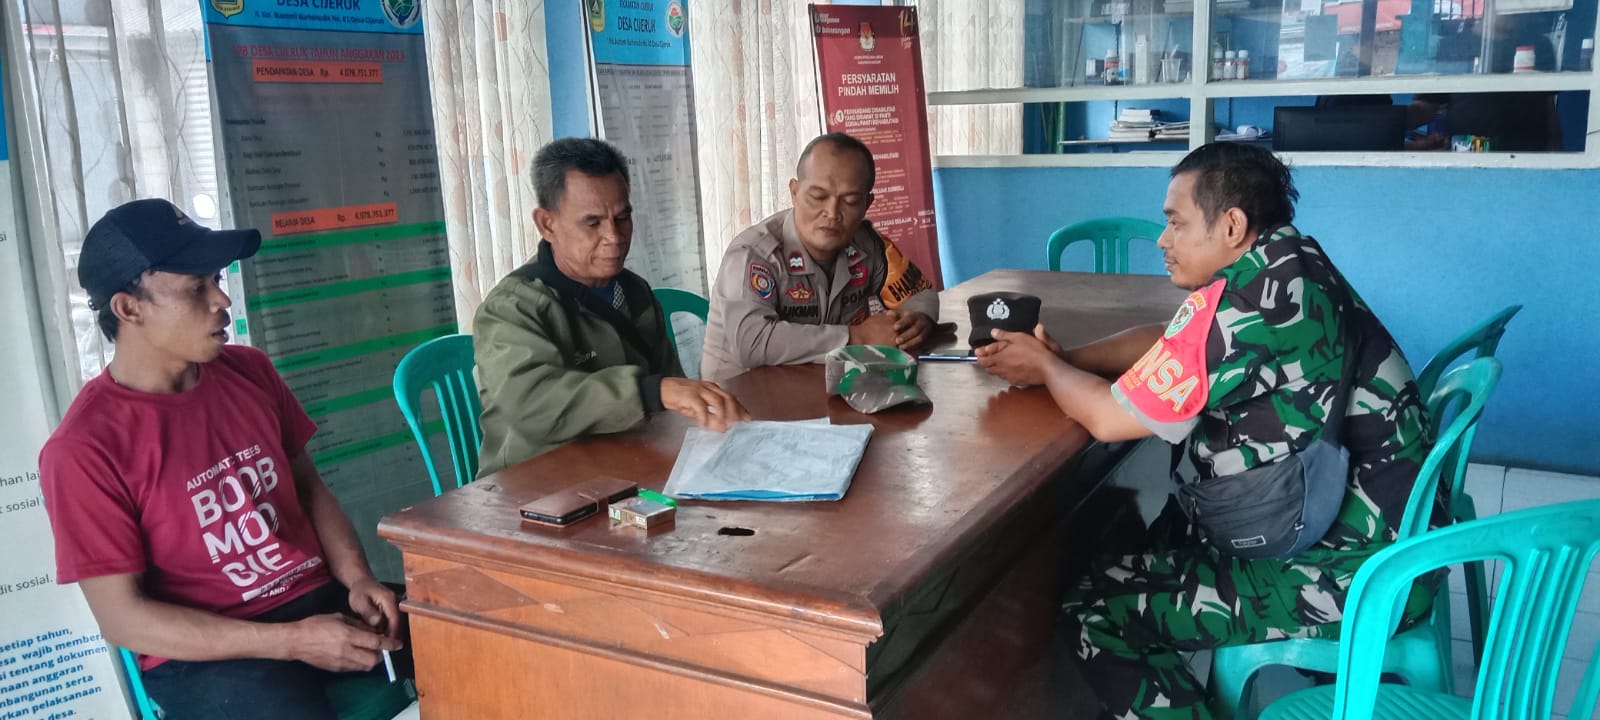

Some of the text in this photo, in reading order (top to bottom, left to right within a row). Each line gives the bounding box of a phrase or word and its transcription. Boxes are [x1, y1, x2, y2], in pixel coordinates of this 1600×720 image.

[618, 16, 632, 31] DESA
[842, 72, 896, 85] PERSYARATAN
[838, 84, 900, 97] PINDAH MEMILIH
[236, 444, 262, 463] TEES
[191, 457, 279, 529] BOOB
[6, 496, 40, 513] sosial
[15, 573, 53, 591] sosial.
[0, 627, 73, 653] setiap tahun,
[10, 658, 55, 678] tentang
[57, 645, 107, 664] dokumen
[22, 644, 53, 661] wajib
[32, 664, 84, 685] anggaran
[65, 674, 94, 689] serta
[32, 685, 102, 714] pelaksanaan
